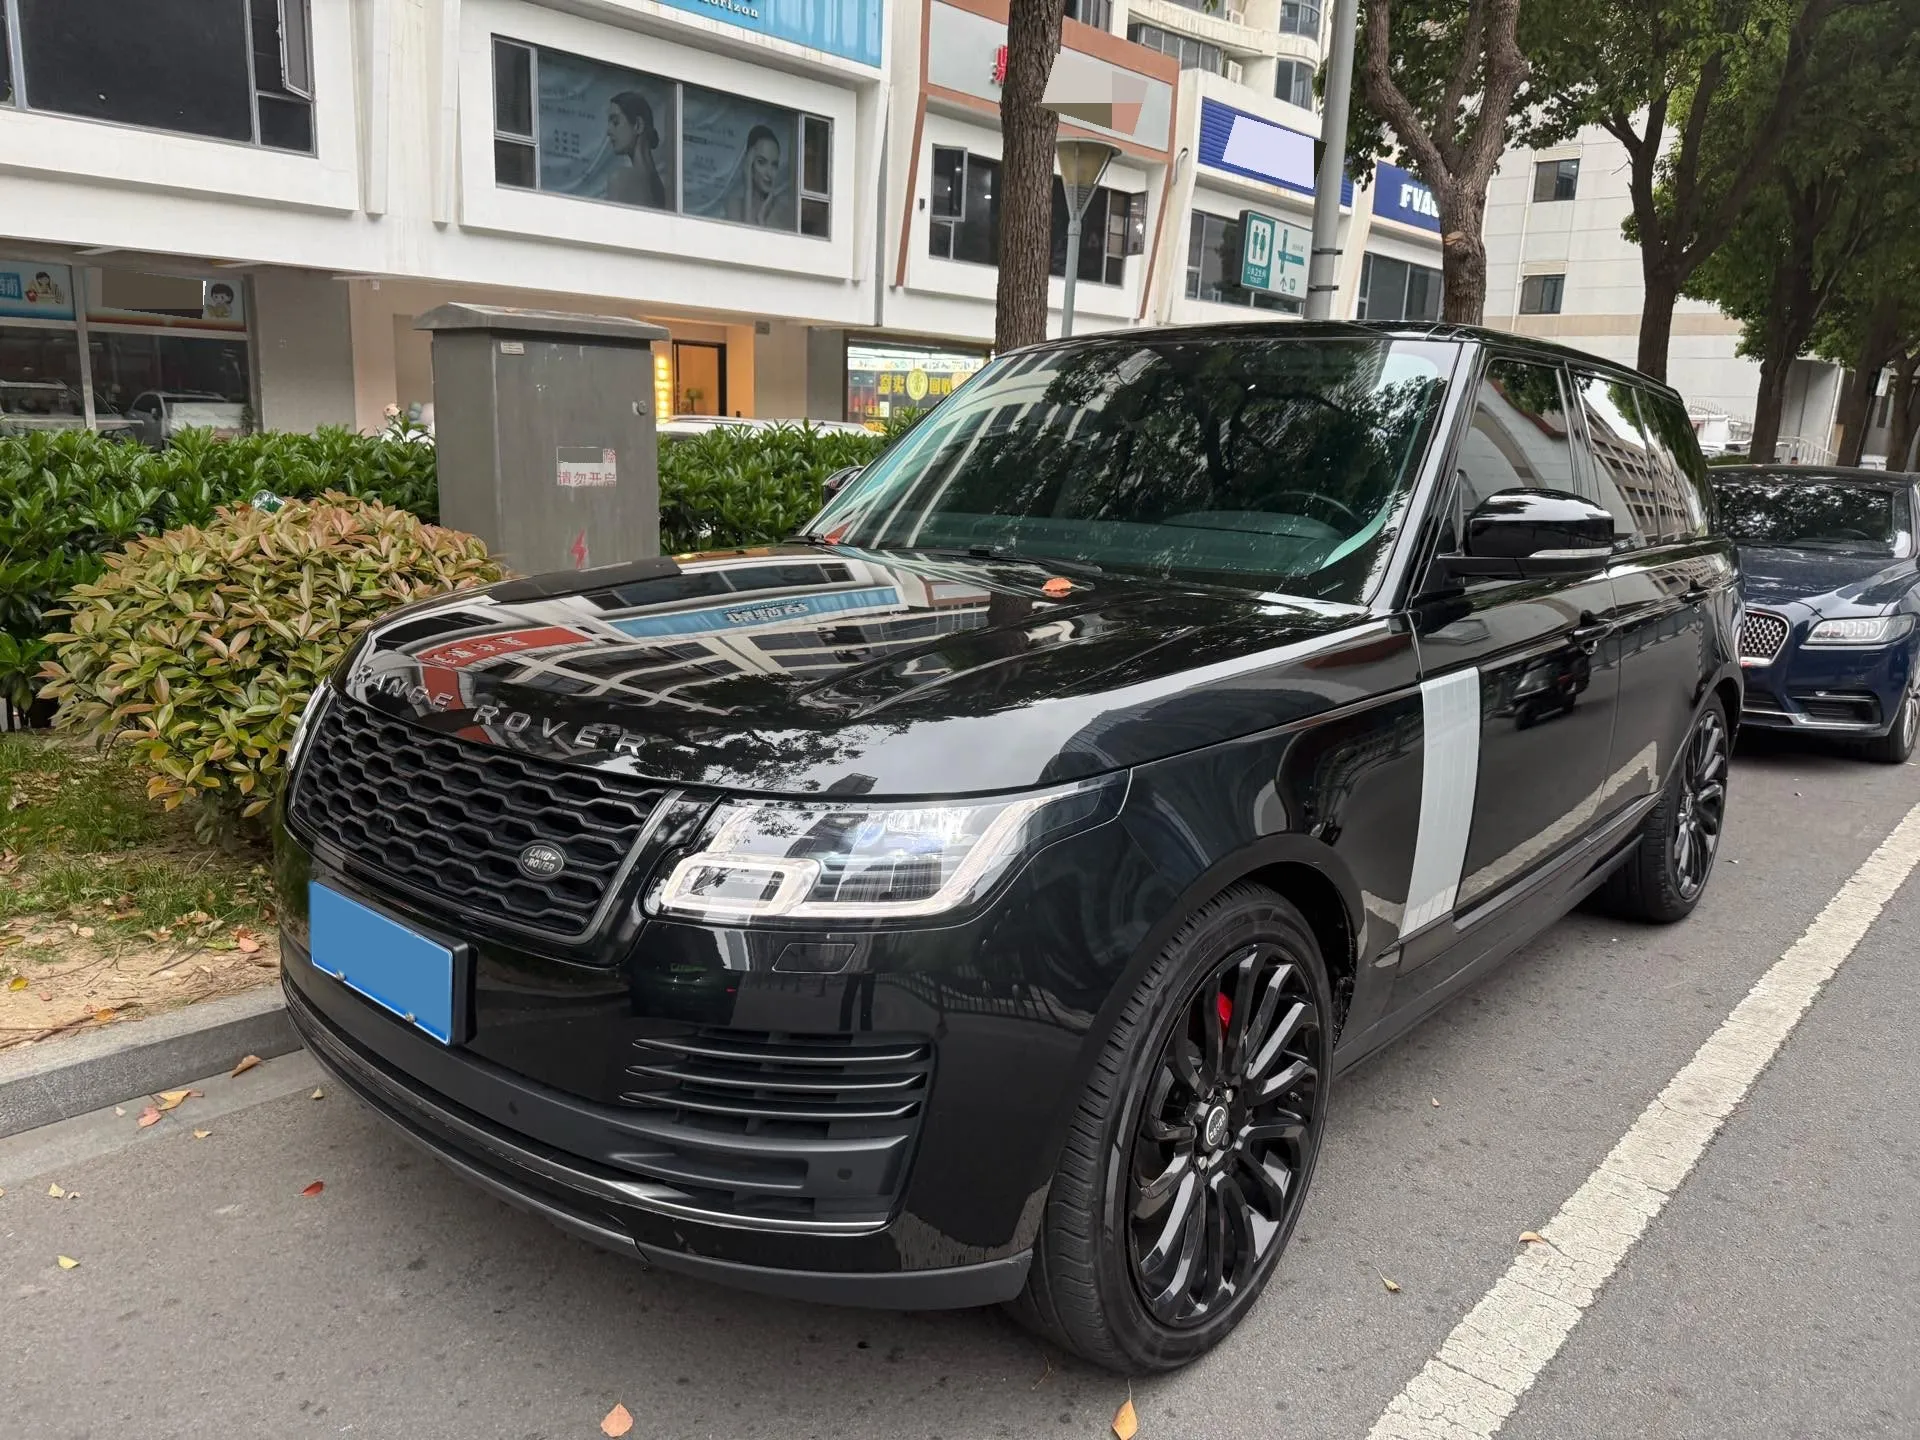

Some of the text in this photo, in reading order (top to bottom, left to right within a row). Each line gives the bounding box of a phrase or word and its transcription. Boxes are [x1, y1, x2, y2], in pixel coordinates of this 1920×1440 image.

[558, 470, 616, 487] 请勿开启
[355, 664, 646, 756] RANGE ROVER
[529, 848, 552, 861] LAND
[527, 857, 555, 872] ROVER
